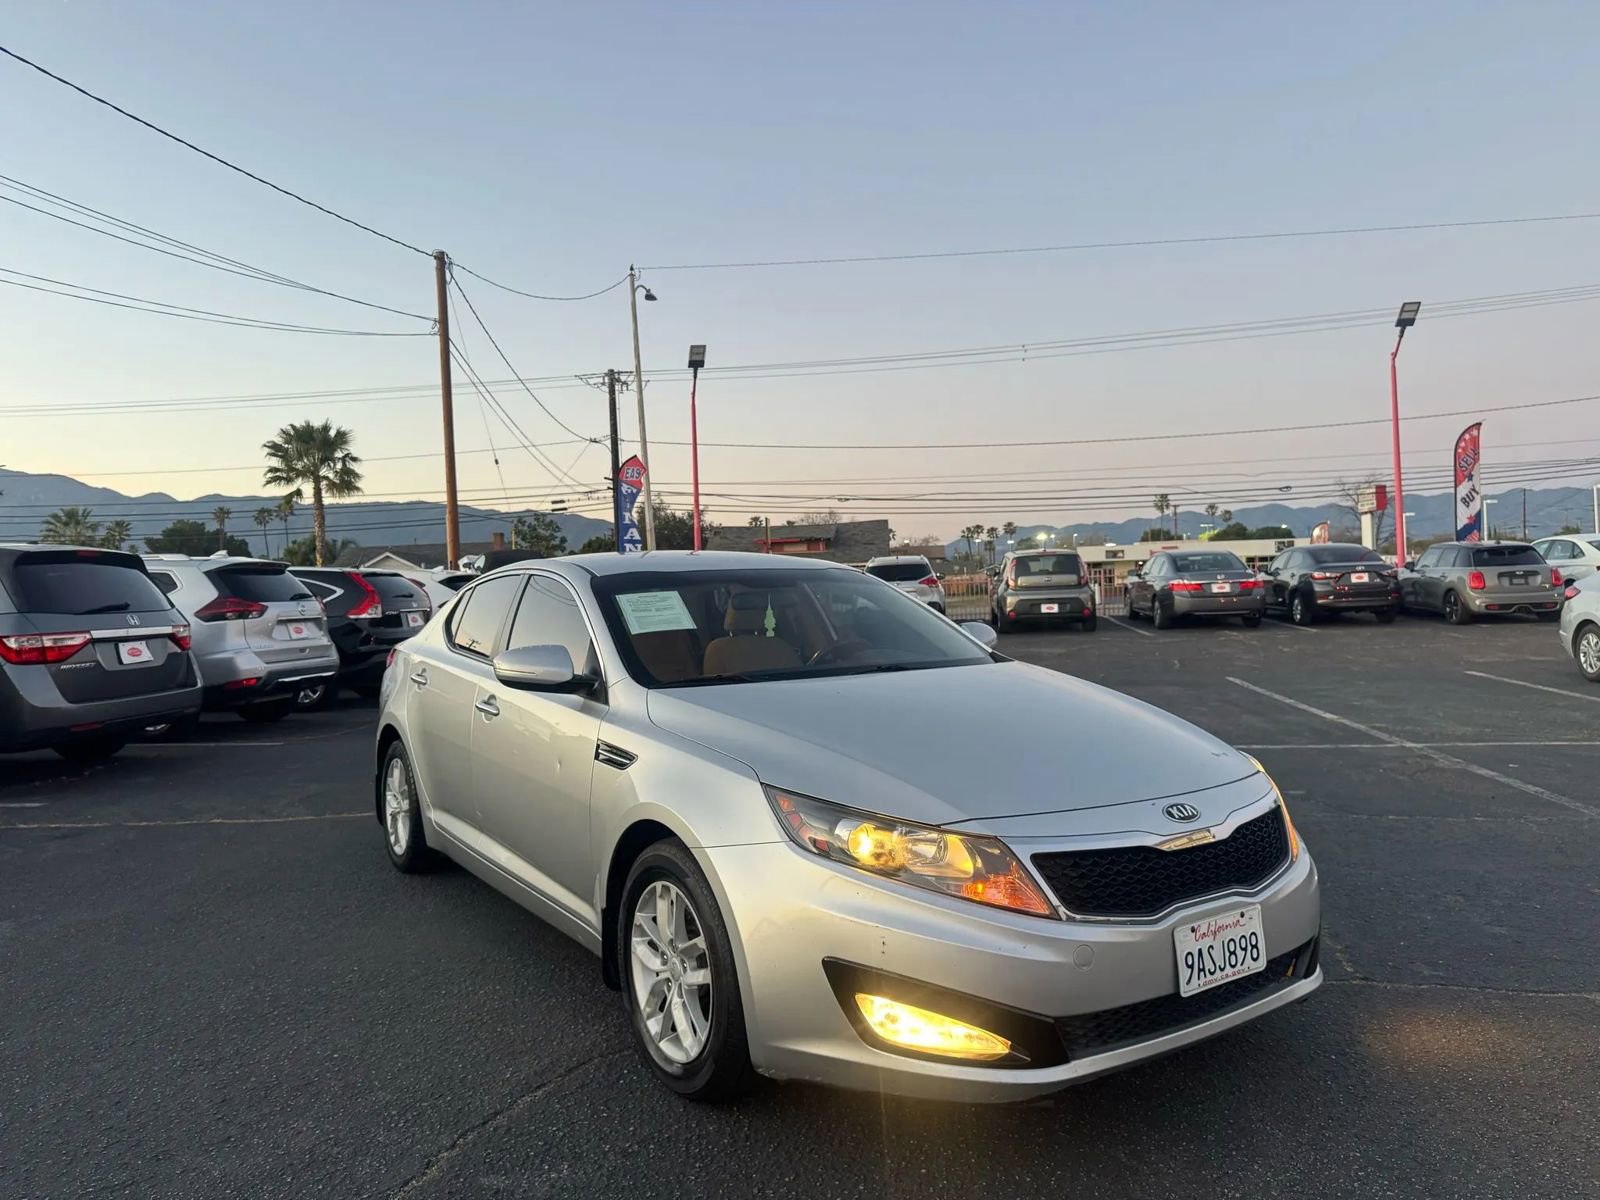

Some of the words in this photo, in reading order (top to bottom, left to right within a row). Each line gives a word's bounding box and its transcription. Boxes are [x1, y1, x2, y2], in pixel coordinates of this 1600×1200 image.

[1460, 484, 1480, 508] BUY
[1168, 804, 1198, 819] KIA
[1193, 916, 1246, 942] California
[1184, 931, 1260, 986] 9ASJ898
[1202, 967, 1247, 987] dmv.ca.gov
